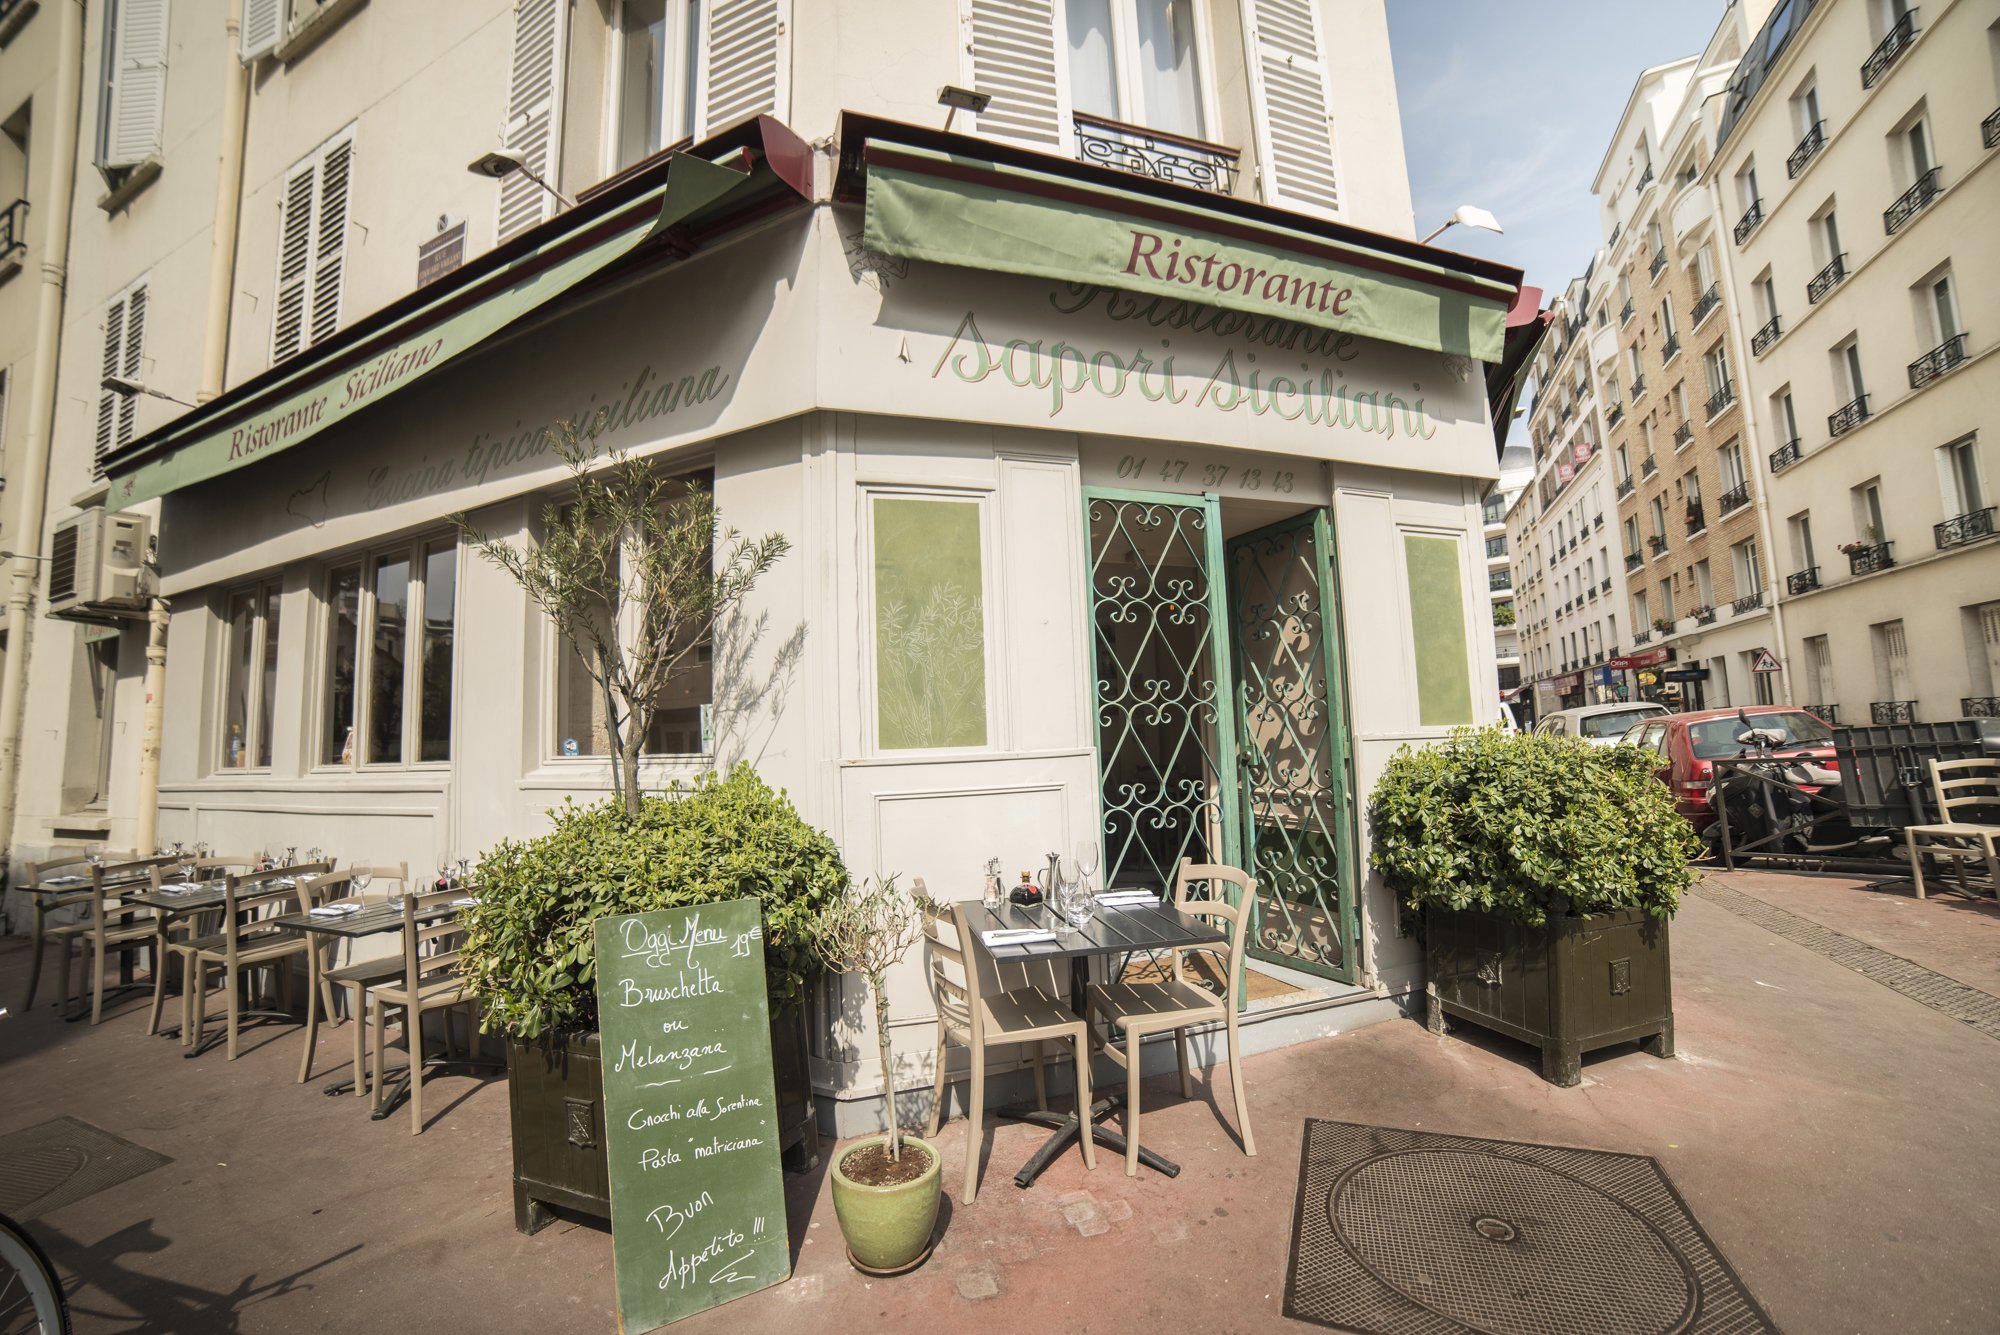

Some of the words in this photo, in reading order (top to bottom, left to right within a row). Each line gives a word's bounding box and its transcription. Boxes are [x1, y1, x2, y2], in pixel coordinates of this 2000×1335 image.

[1120, 230, 1352, 316] Ristorante
[228, 396, 327, 462] Ristorante
[340, 338, 443, 409] Siciliano
[931, 310, 1189, 417] Sapori
[1195, 348, 1437, 440] Siciliani
[363, 456, 457, 510] Cucina
[461, 420, 551, 486] tipica
[1117, 455, 1148, 479] 01
[1159, 460, 1189, 483] 47
[1202, 464, 1231, 488] 37
[1240, 468, 1262, 491] 13
[620, 918, 677, 968] Oggi
[679, 913, 727, 970] Menu
[618, 967, 725, 1007] Bruschetta
[663, 1020, 689, 1033] ou
[614, 1039, 727, 1073] Melanzana
[628, 1104, 681, 1131] Gnocchi
[686, 1098, 711, 1119] alla
[709, 1094, 763, 1121] Sorentina
[638, 1148, 682, 1171] Pasta
[646, 1191, 714, 1241] Buon
[659, 1228, 744, 1290] Appetito
